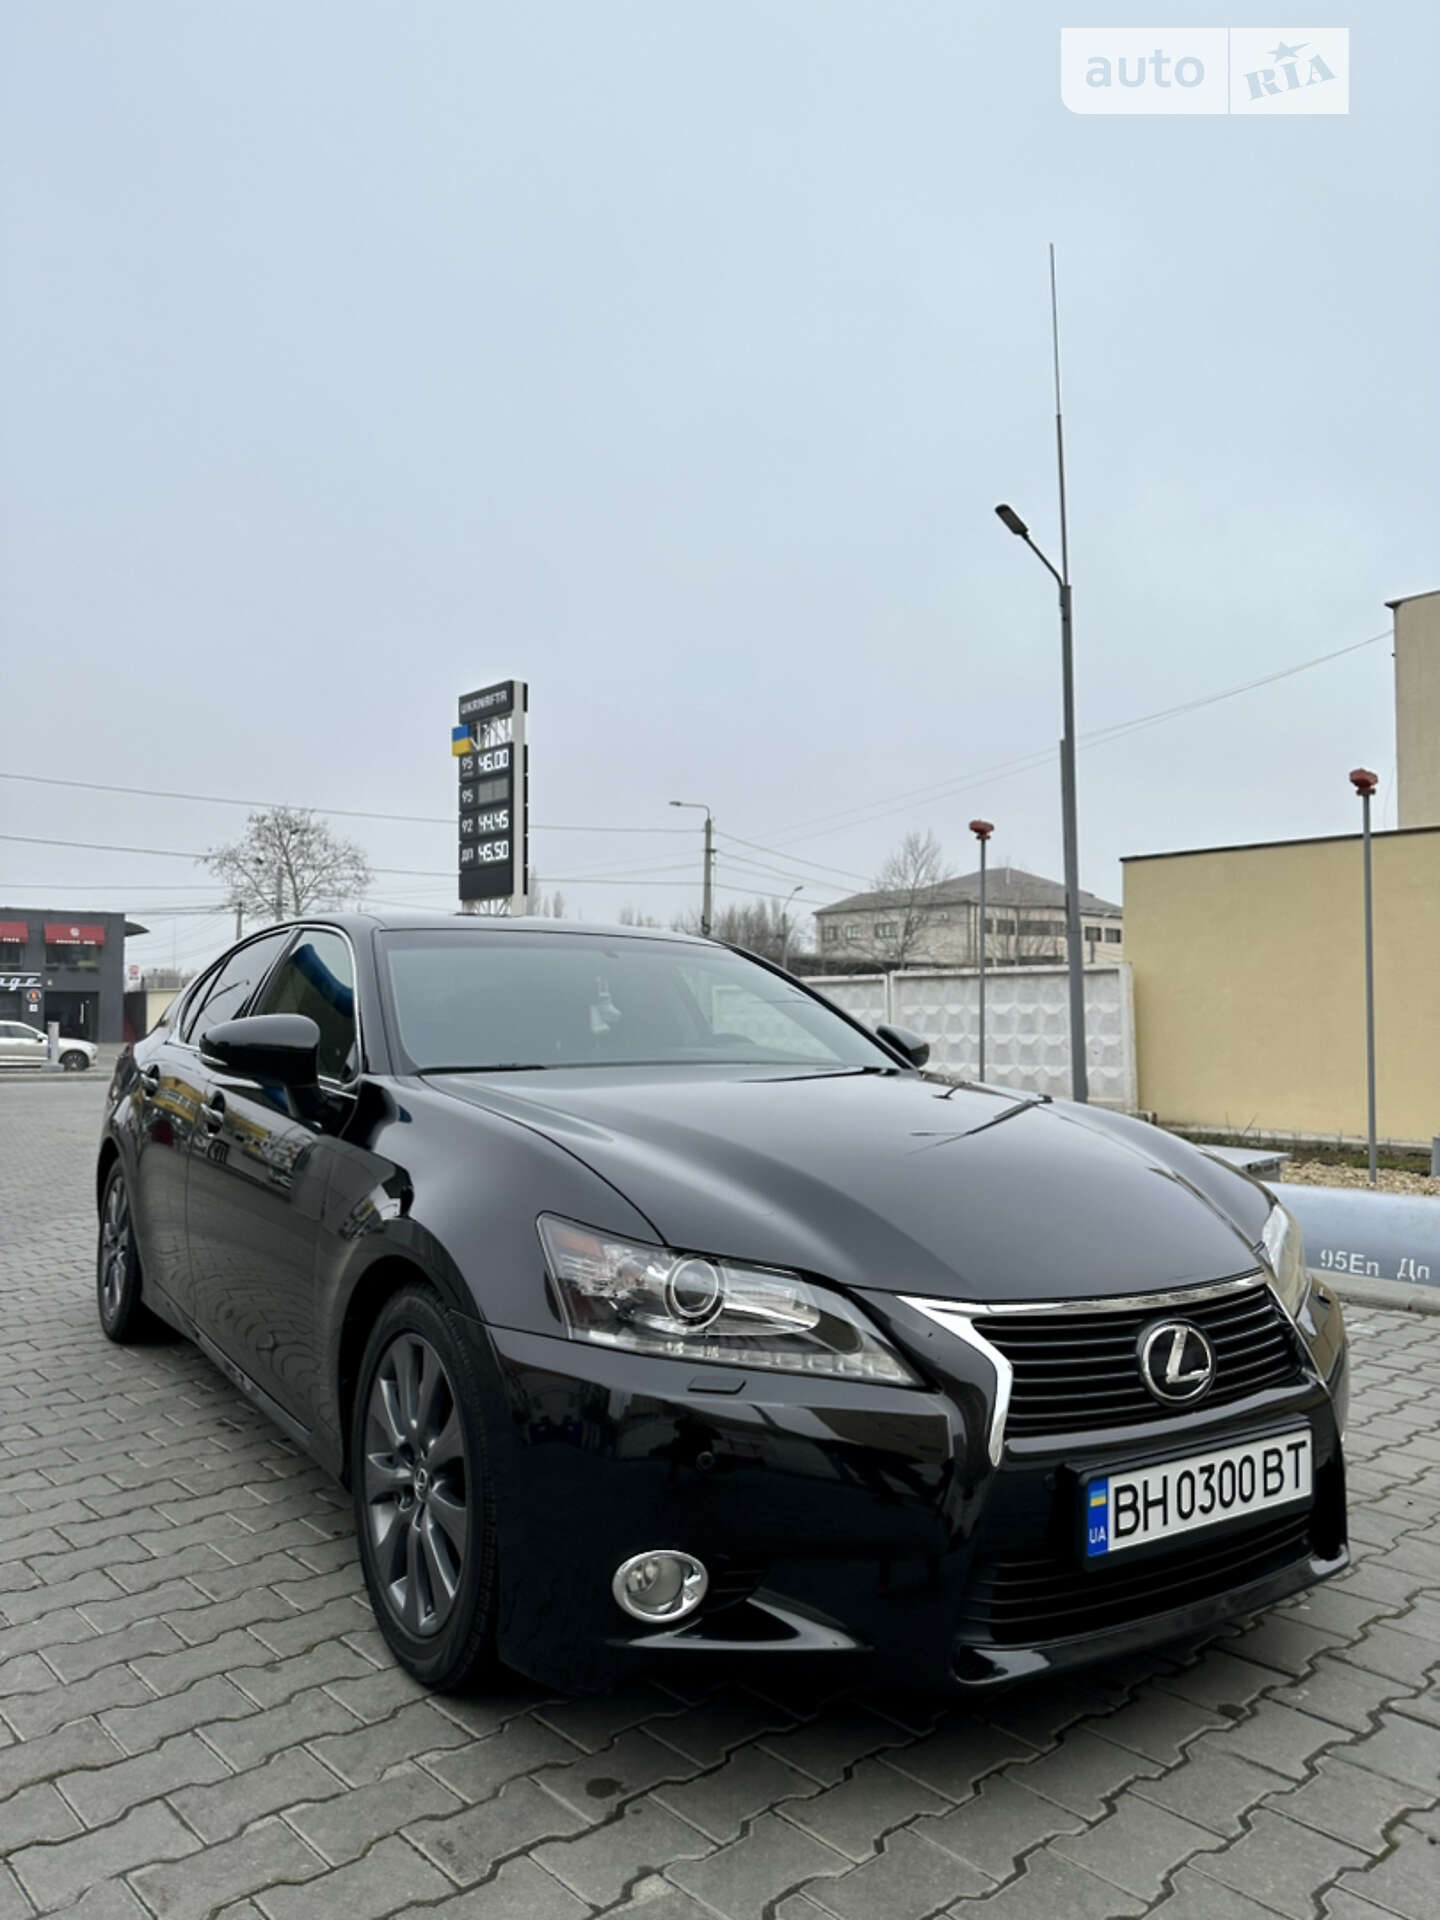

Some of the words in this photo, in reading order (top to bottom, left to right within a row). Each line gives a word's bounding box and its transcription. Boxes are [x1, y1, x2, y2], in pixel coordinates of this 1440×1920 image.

[462, 756, 474, 771] 95
[478, 748, 509, 772] 46.00
[462, 788, 474, 803] 95
[462, 817, 474, 832] 92
[1089, 1526, 1107, 1545] UA
